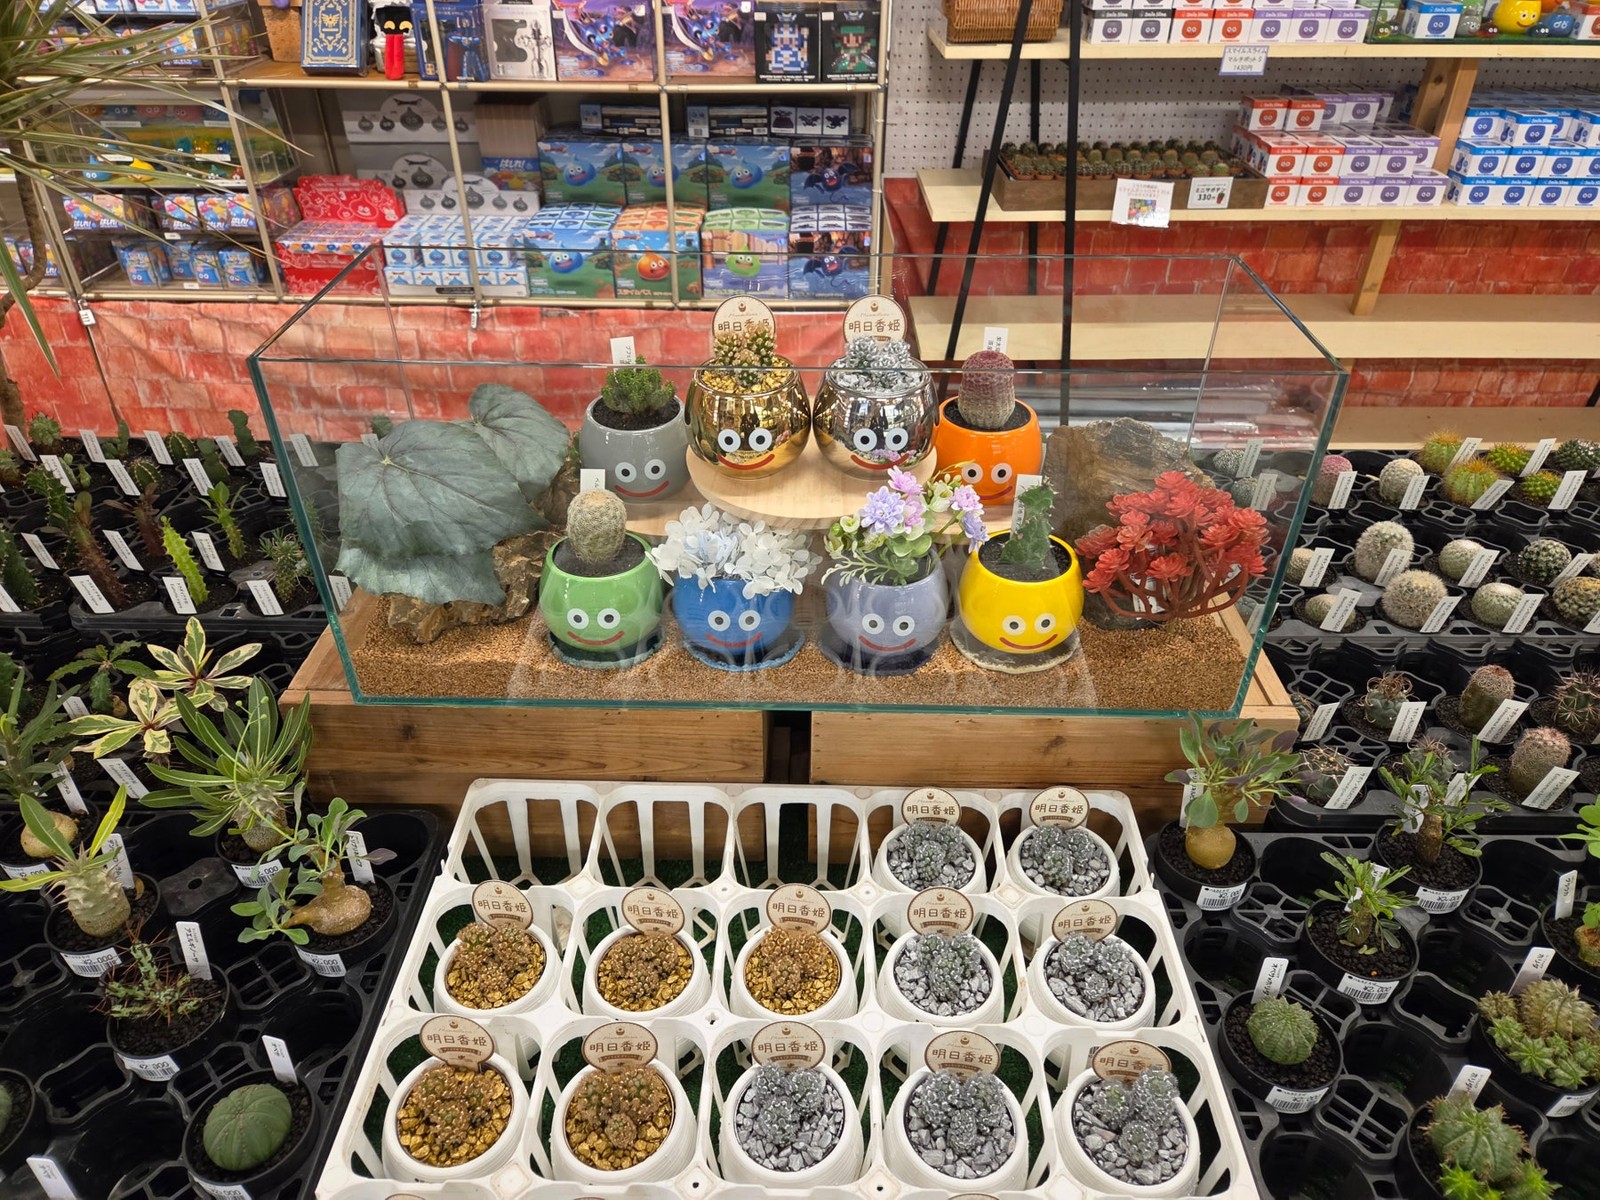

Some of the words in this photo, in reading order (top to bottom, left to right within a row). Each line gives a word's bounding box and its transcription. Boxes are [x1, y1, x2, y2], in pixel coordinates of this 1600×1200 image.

[500, 159, 525, 169] はしれ!
[849, 319, 900, 332] 明日香姫
[907, 805, 956, 815] 明日香姫
[1035, 804, 1083, 814] 明日香姫
[351, 836, 362, 867] トリプリネビア
[478, 900, 528, 913] 明日香姫
[627, 905, 679, 918] 明日香姫
[772, 902, 826, 917] 明日香姫
[914, 908, 968, 918] 明日香姫
[1058, 916, 1112, 928] 明日香姫
[82, 953, 113, 966] ¥2,000
[427, 1034, 487, 1046] 明日香姫
[589, 1040, 651, 1052] 明日香姫
[758, 1041, 818, 1053] 明日香姫
[932, 1050, 993, 1064] 明日香姫
[1100, 1057, 1163, 1070] 明日香
